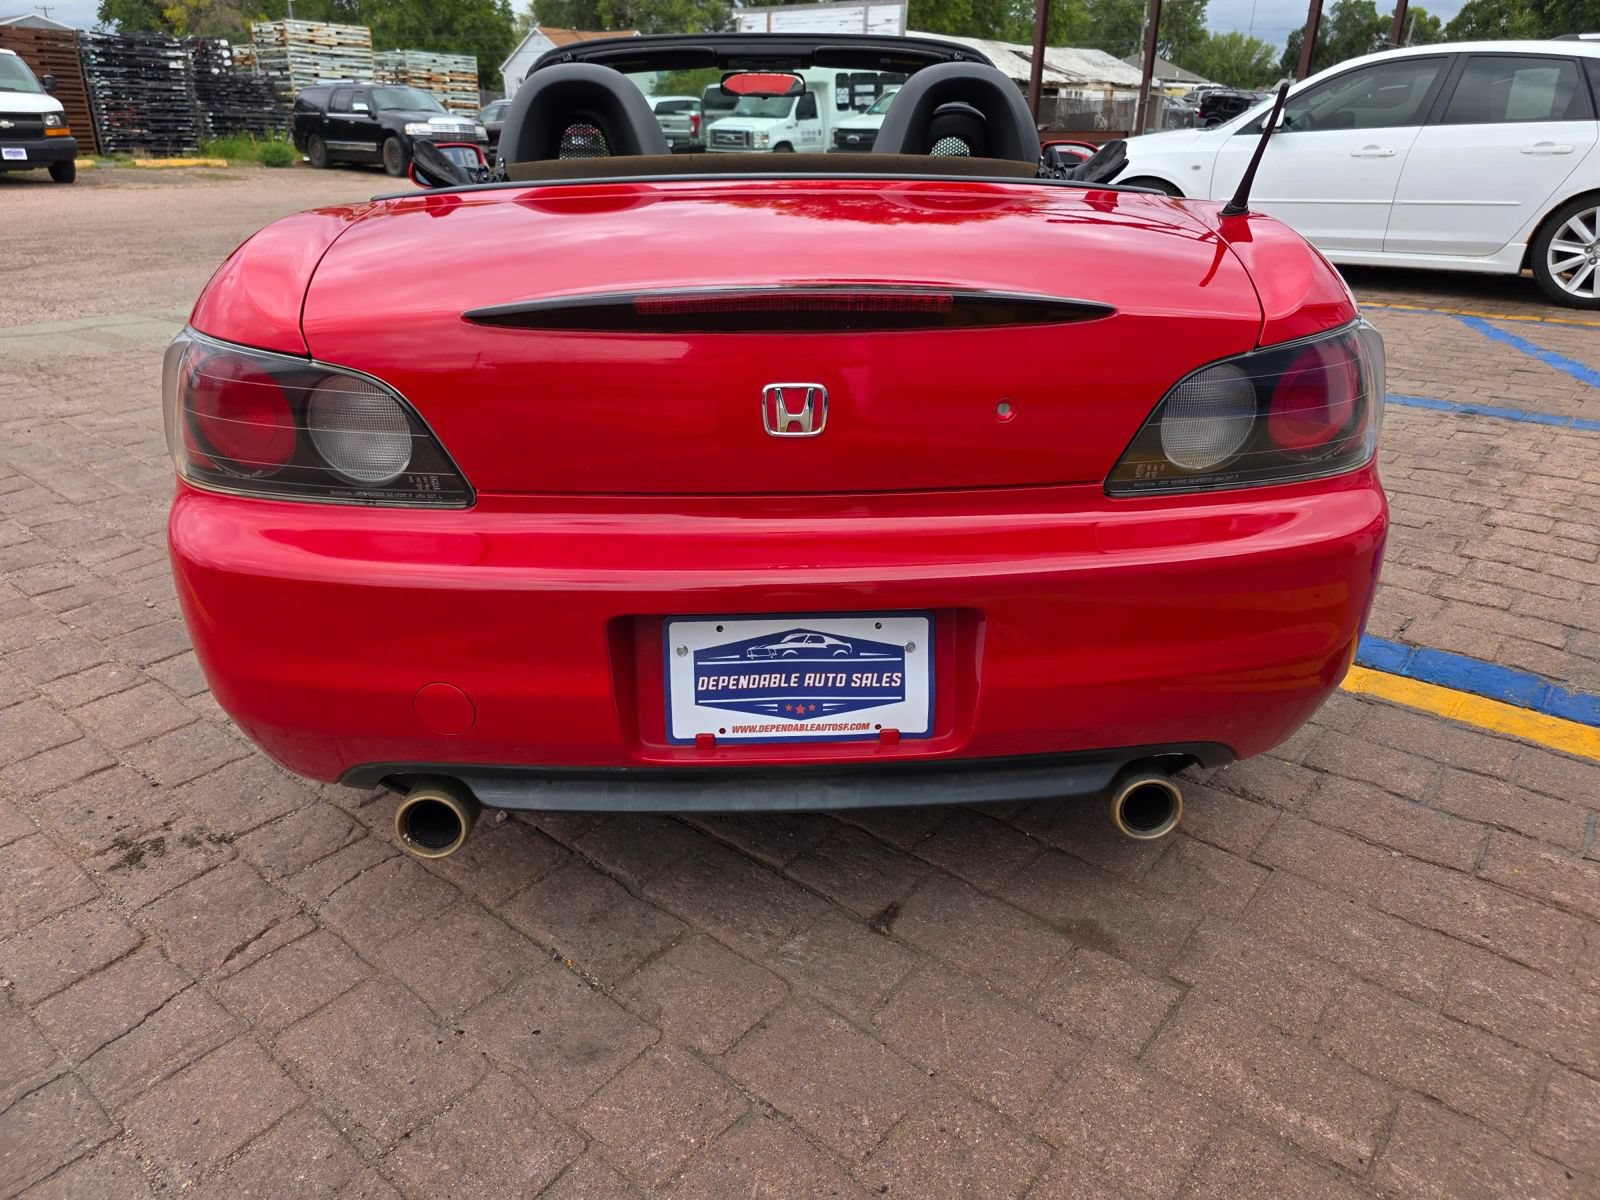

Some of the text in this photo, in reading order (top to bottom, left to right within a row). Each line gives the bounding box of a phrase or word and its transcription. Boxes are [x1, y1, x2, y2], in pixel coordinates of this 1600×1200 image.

[697, 672, 902, 691] DEPENDABLE AUTO SALES
[731, 722, 871, 734] WWW.DEPENDABLEAUTOSF.COM
